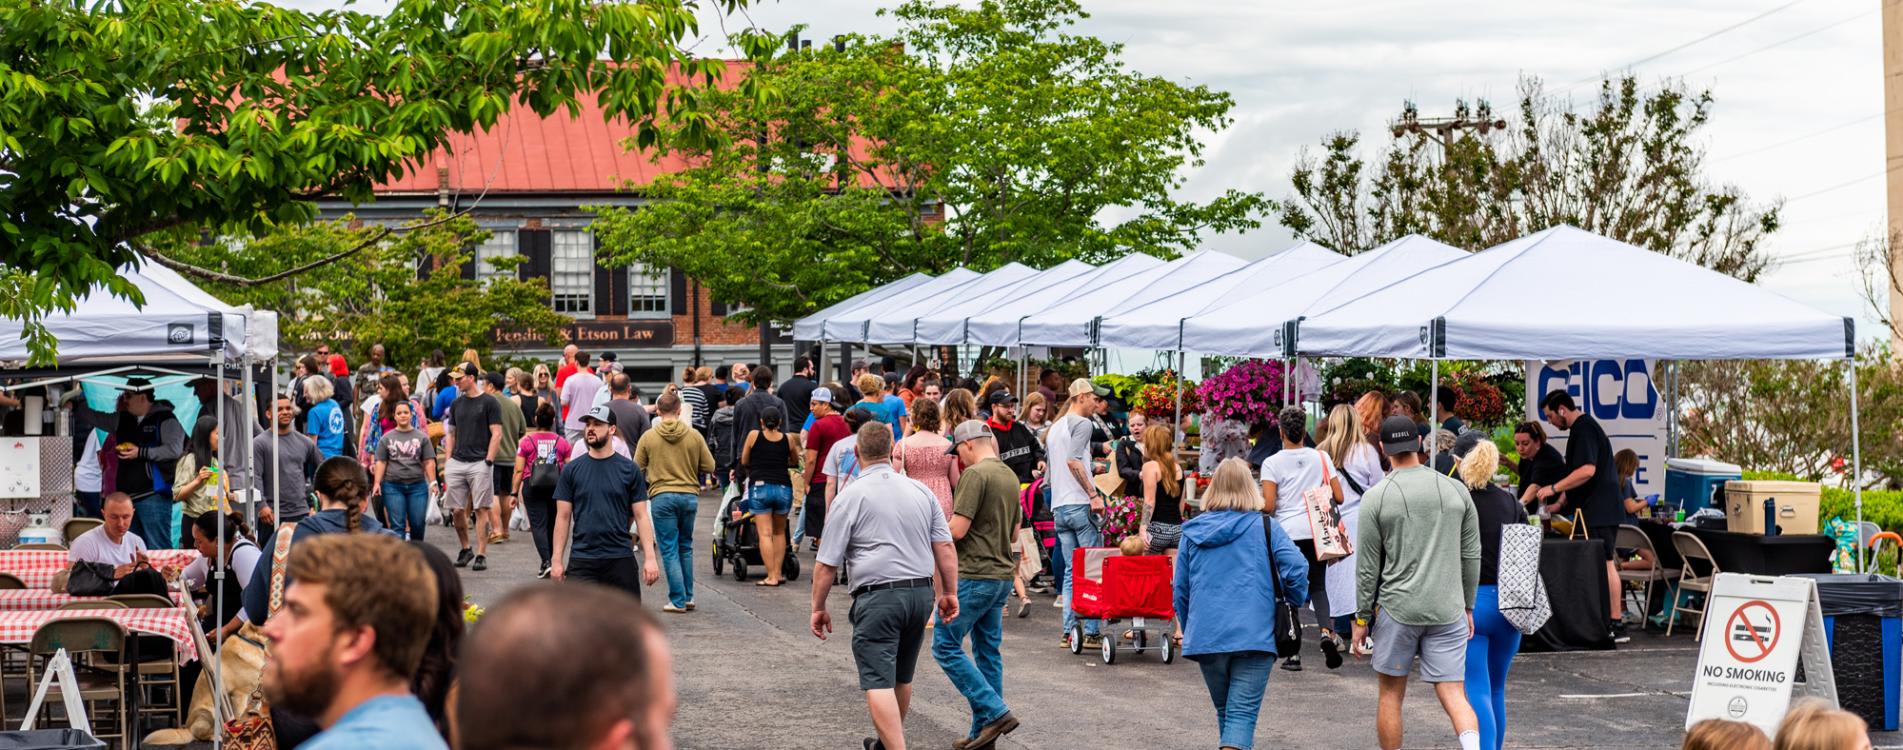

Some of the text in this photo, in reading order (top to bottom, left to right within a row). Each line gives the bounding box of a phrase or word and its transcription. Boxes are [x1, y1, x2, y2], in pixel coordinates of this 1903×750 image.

[559, 327, 573, 341] &
[578, 326, 619, 341] Etson
[623, 326, 655, 340] Law
[1538, 359, 1657, 421] GEICO
[1703, 666, 1785, 683] NO SMOKING
